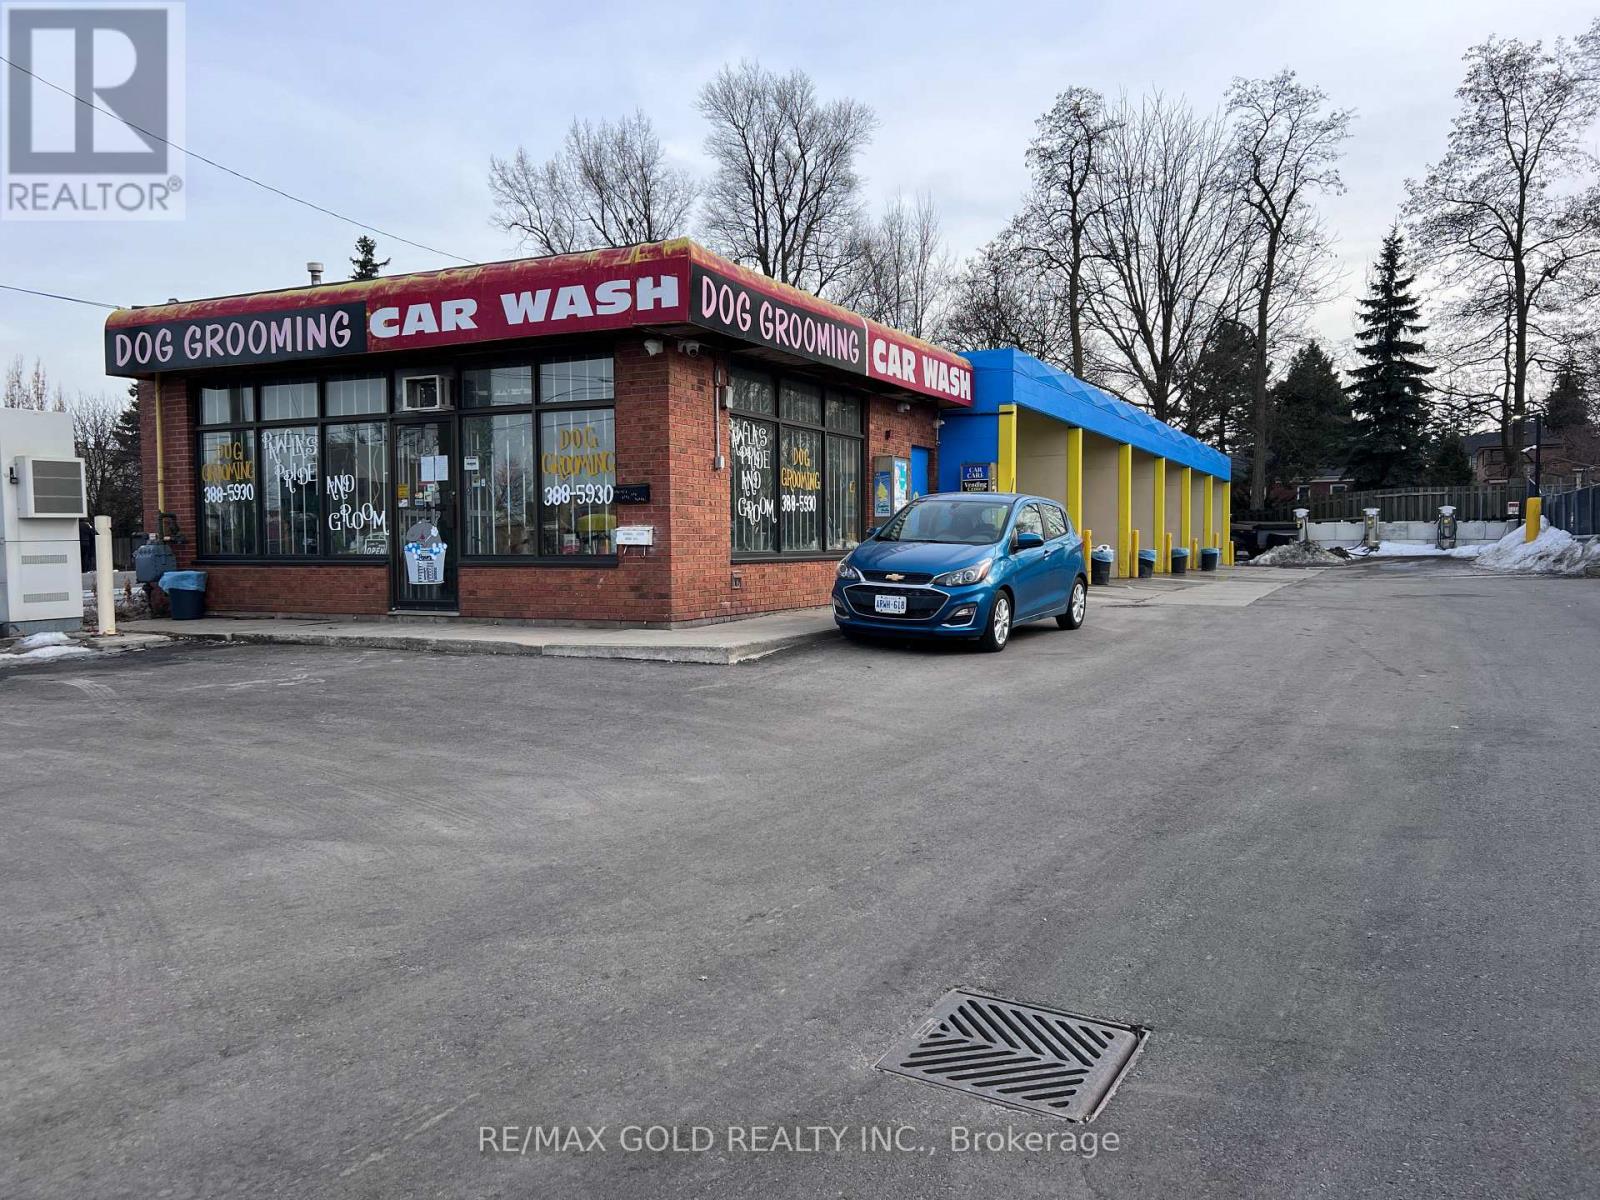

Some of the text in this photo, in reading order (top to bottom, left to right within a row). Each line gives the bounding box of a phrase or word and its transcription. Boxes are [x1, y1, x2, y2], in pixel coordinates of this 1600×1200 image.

[369, 274, 679, 338] CAR WASH
[701, 276, 860, 364] DOG GROOMING
[115, 310, 351, 367] DOG GROOMING
[873, 338, 972, 401] CAR WASH
[560, 426, 599, 450] DOG
[542, 451, 616, 480] GROOMING
[739, 446, 771, 471] PRIDE
[792, 447, 810, 467] DOG
[274, 462, 319, 494] PRIDE
[326, 474, 355, 500] AND
[741, 470, 762, 496] AND
[781, 467, 821, 491] GROOMING
[204, 483, 254, 503] 388-5930
[544, 484, 614, 506] 388-5930
[781, 494, 817, 512] 388-5930
[328, 502, 390, 535] GROOM
[738, 497, 778, 526] GROOM
